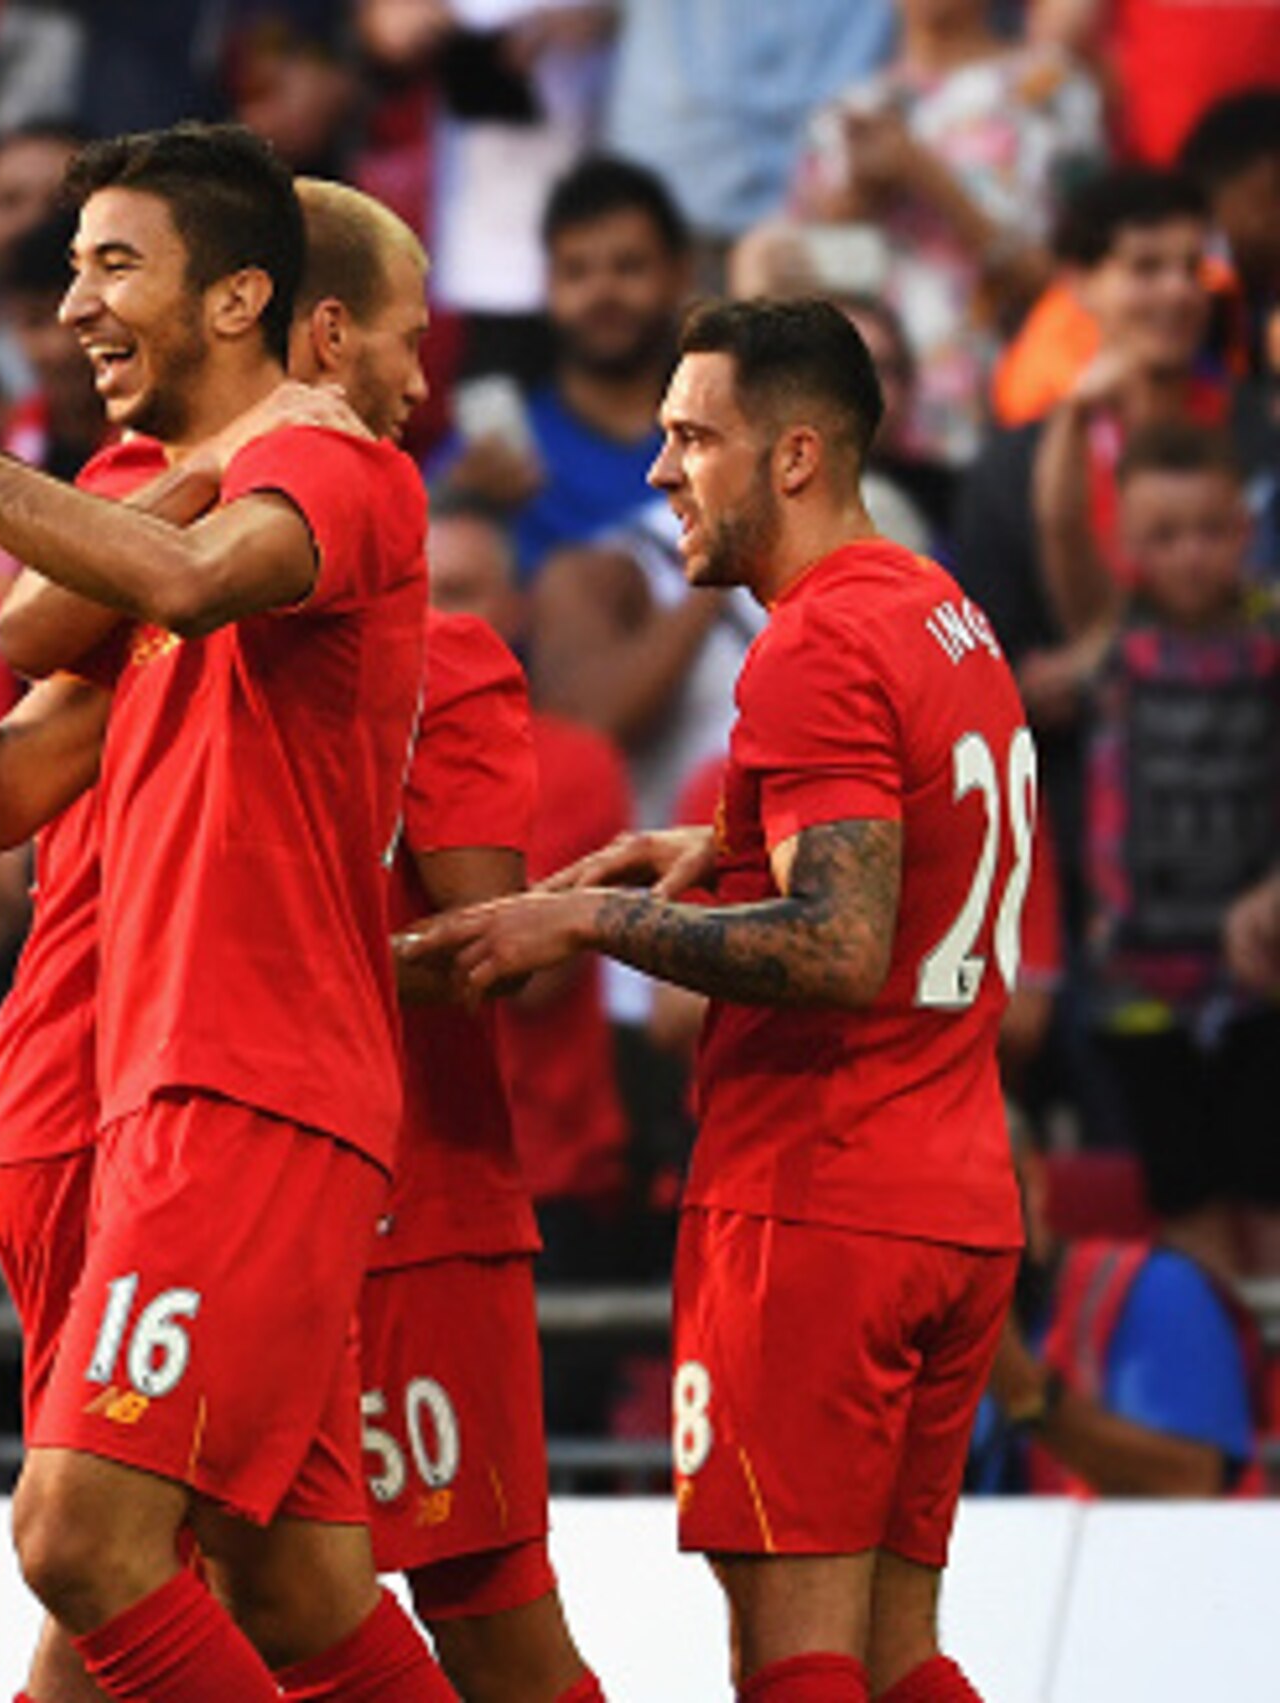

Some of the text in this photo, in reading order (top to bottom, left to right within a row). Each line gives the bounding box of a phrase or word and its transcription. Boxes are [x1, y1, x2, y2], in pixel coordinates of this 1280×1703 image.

[924, 596, 1001, 666] ING
[85, 1271, 202, 1398] 16
[360, 1375, 460, 1503] 50
[673, 1360, 713, 1476] 8
